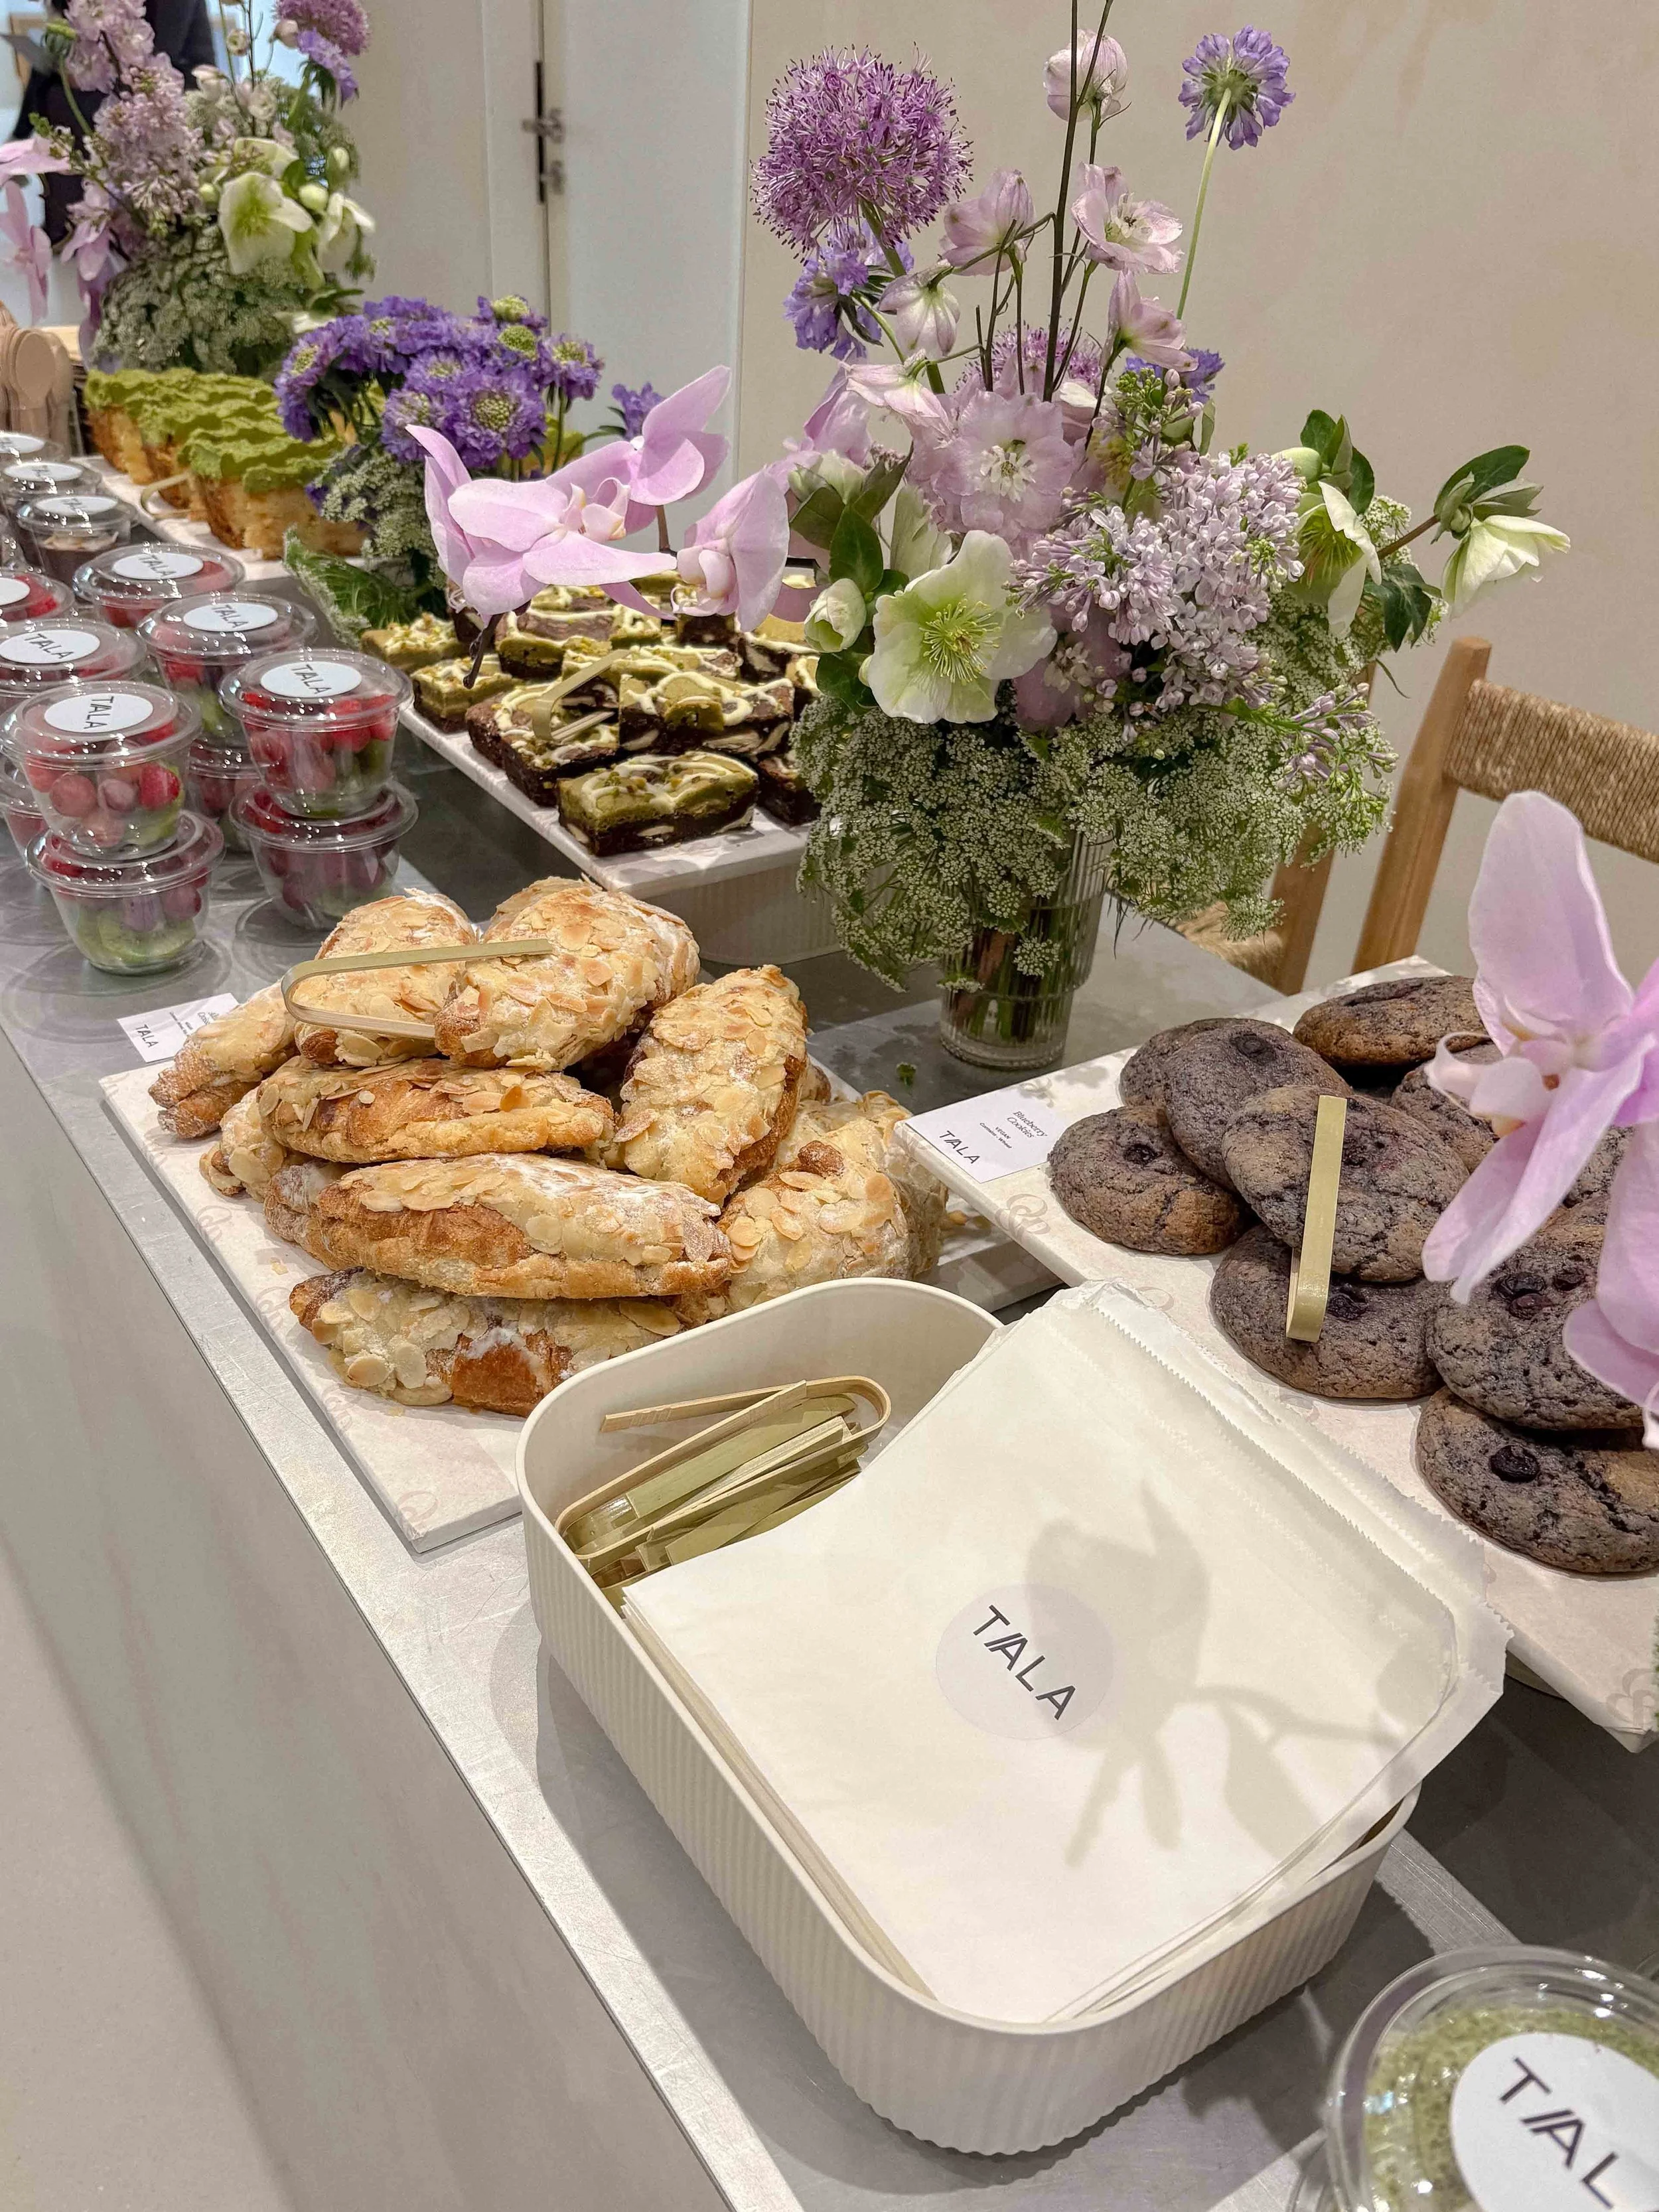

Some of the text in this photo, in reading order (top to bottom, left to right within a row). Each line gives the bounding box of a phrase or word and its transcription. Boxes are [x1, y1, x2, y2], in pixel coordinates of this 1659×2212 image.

[211, 605, 249, 628] TALA
[24, 633, 74, 659] TALA
[291, 664, 332, 694] TALA
[83, 696, 115, 730] TALA
[135, 1024, 159, 1049] TALA
[1007, 1117, 1035, 1138] Cookies
[1013, 1111, 1048, 1137] Blueberry
[939, 1130, 981, 1164] TALA
[973, 1604, 1076, 1720] TALA
[1498, 2057, 1659, 2212] TAL
